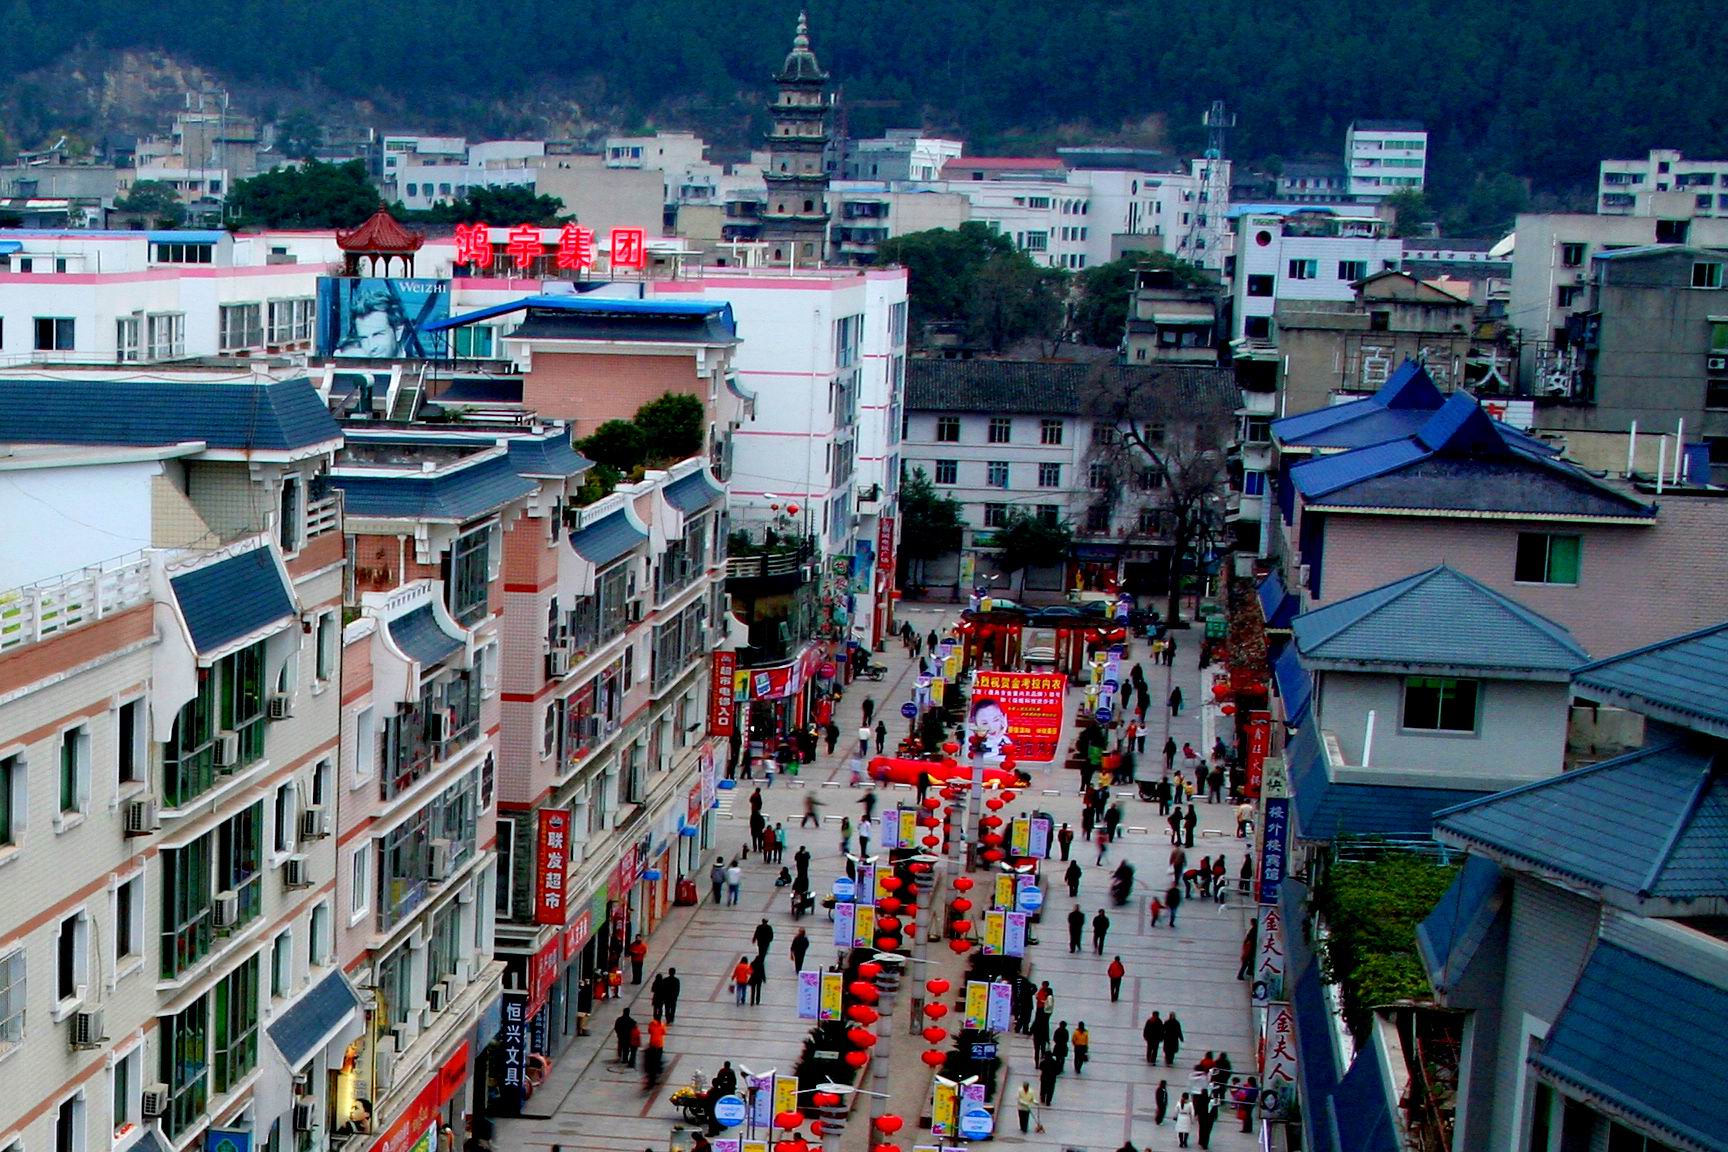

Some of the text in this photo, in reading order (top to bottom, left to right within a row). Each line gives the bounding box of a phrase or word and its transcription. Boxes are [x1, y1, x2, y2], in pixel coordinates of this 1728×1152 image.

[455, 223, 646, 269] 鸿宇集团
[545, 831, 564, 910] 联发超市
[1259, 911, 1282, 975] 金夫人
[504, 1002, 522, 1087] 恒兴文具
[1268, 1010, 1296, 1083] 金夫人
